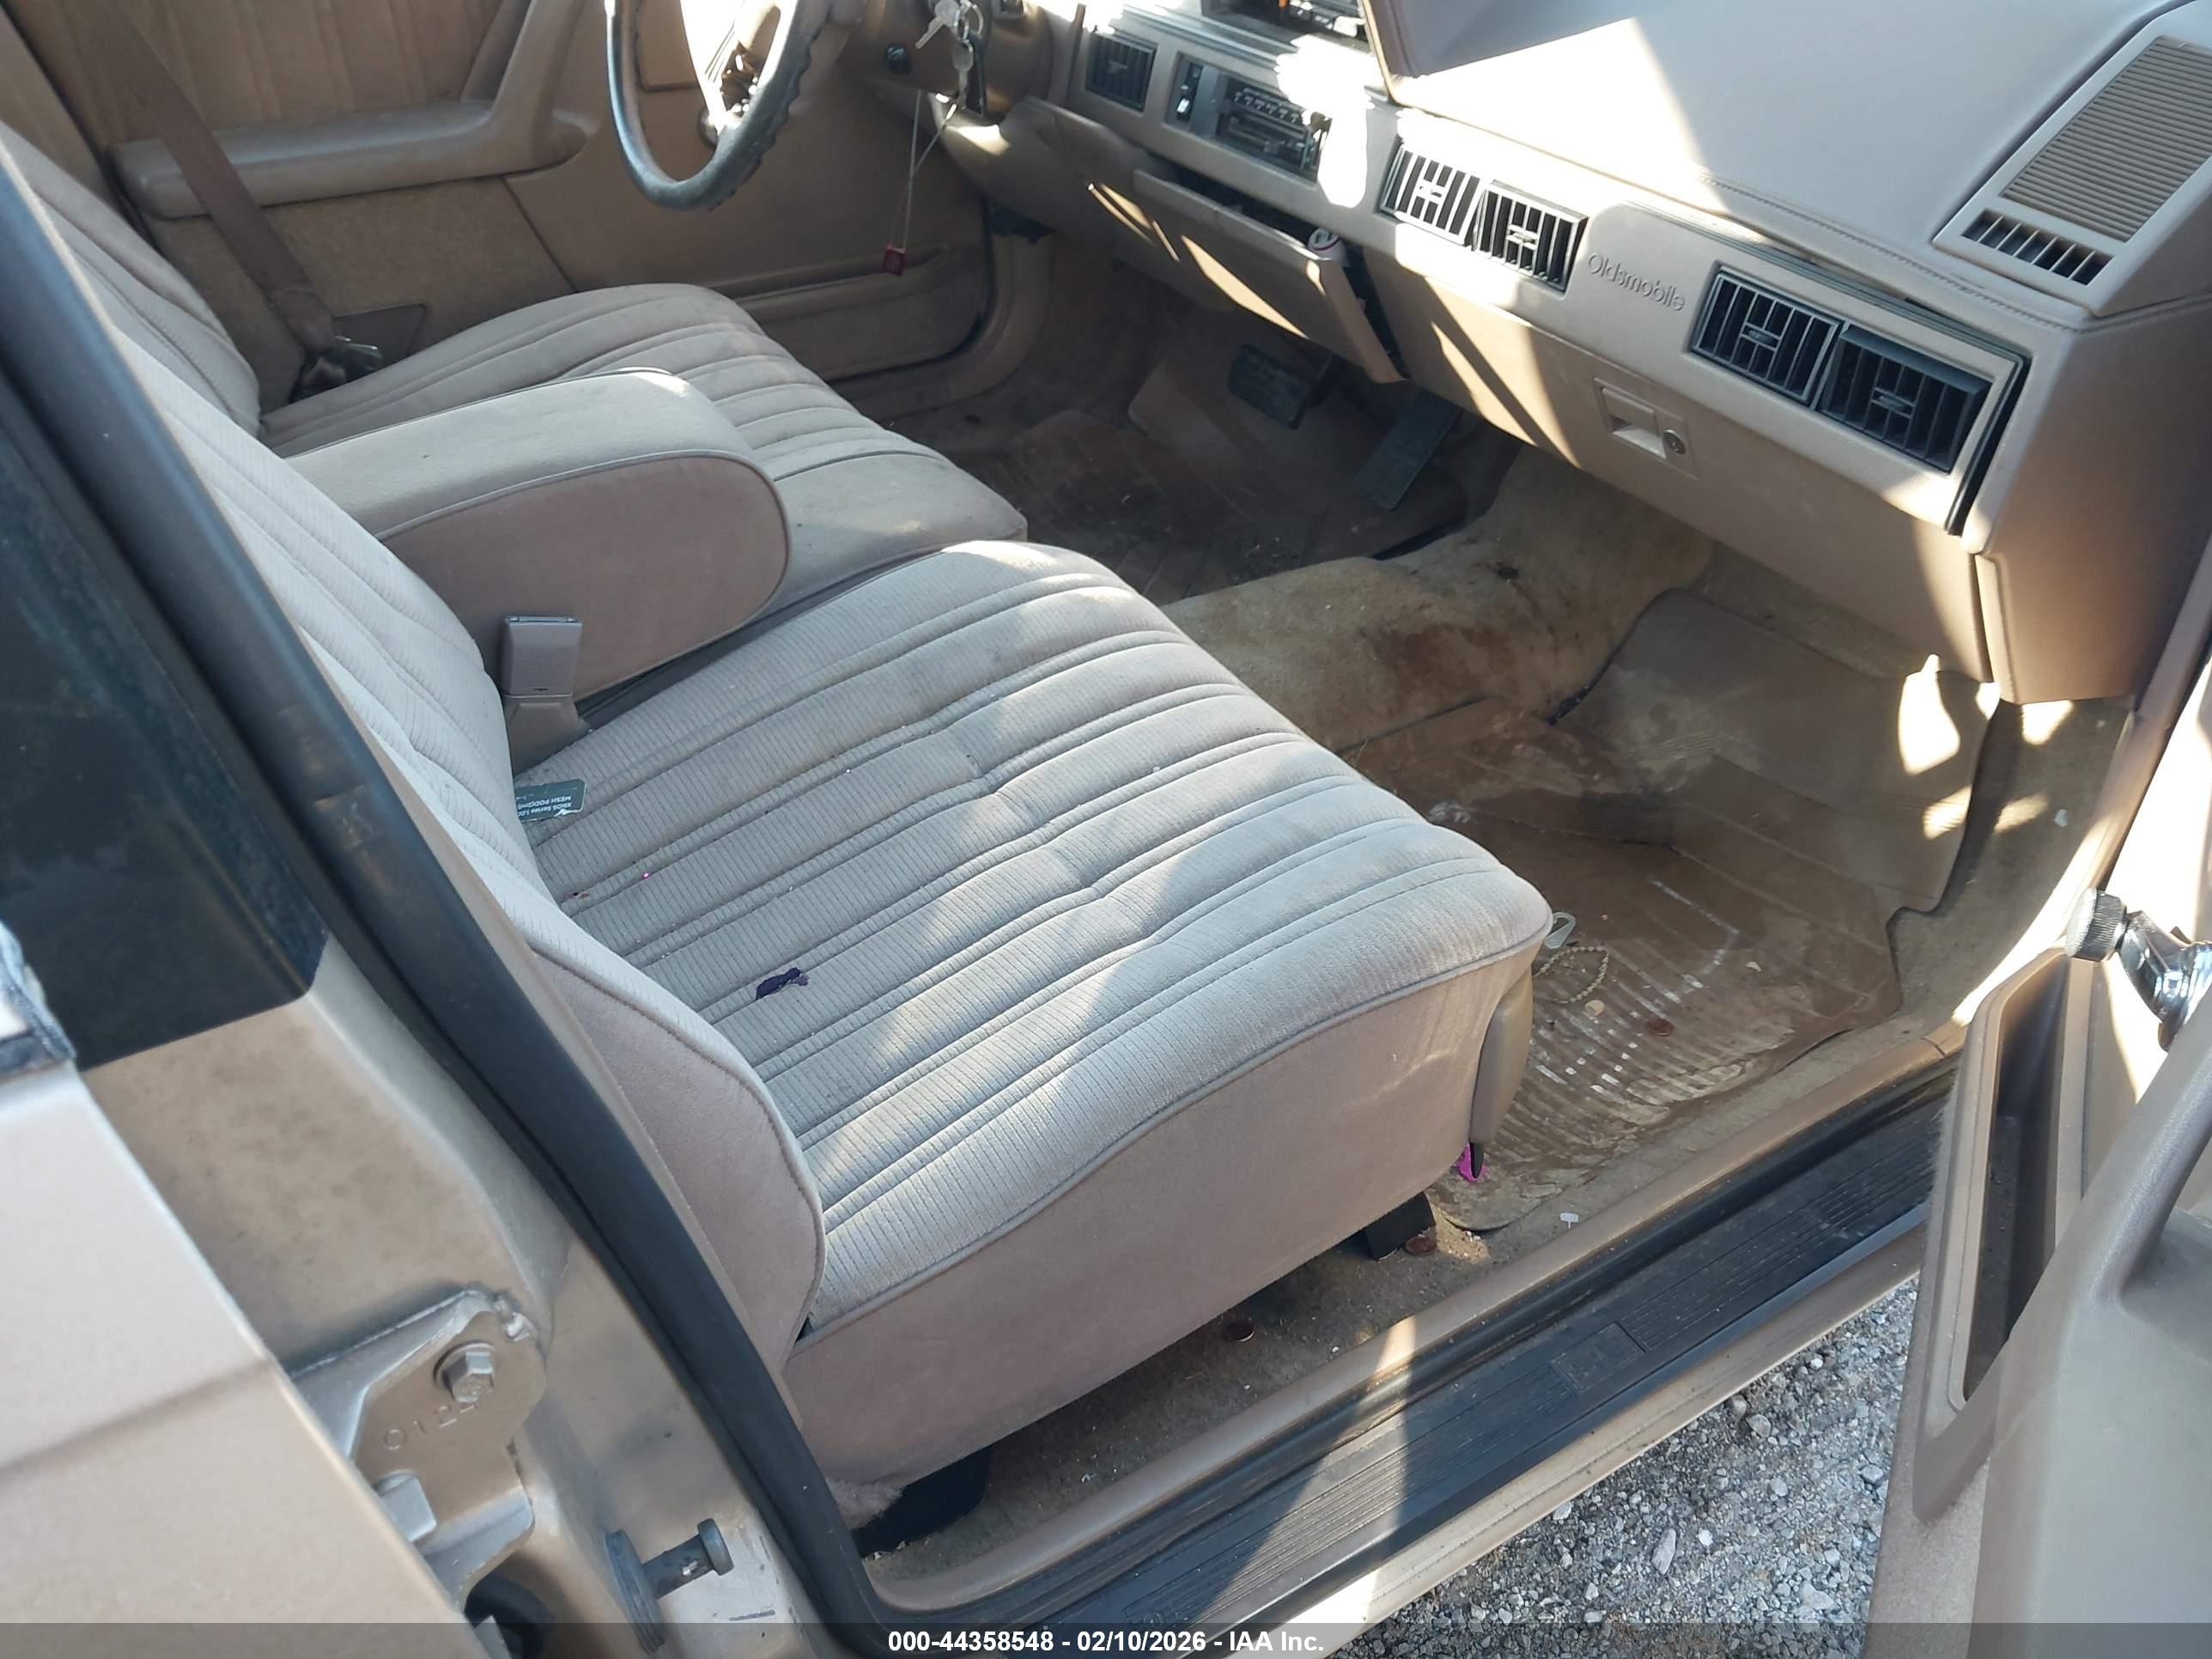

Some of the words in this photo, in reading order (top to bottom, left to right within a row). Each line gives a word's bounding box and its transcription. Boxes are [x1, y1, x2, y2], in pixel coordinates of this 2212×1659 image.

[1587, 252, 1686, 312] Oldsmobile
[550, 795, 572, 804] MESH
[531, 805, 551, 814] Series
